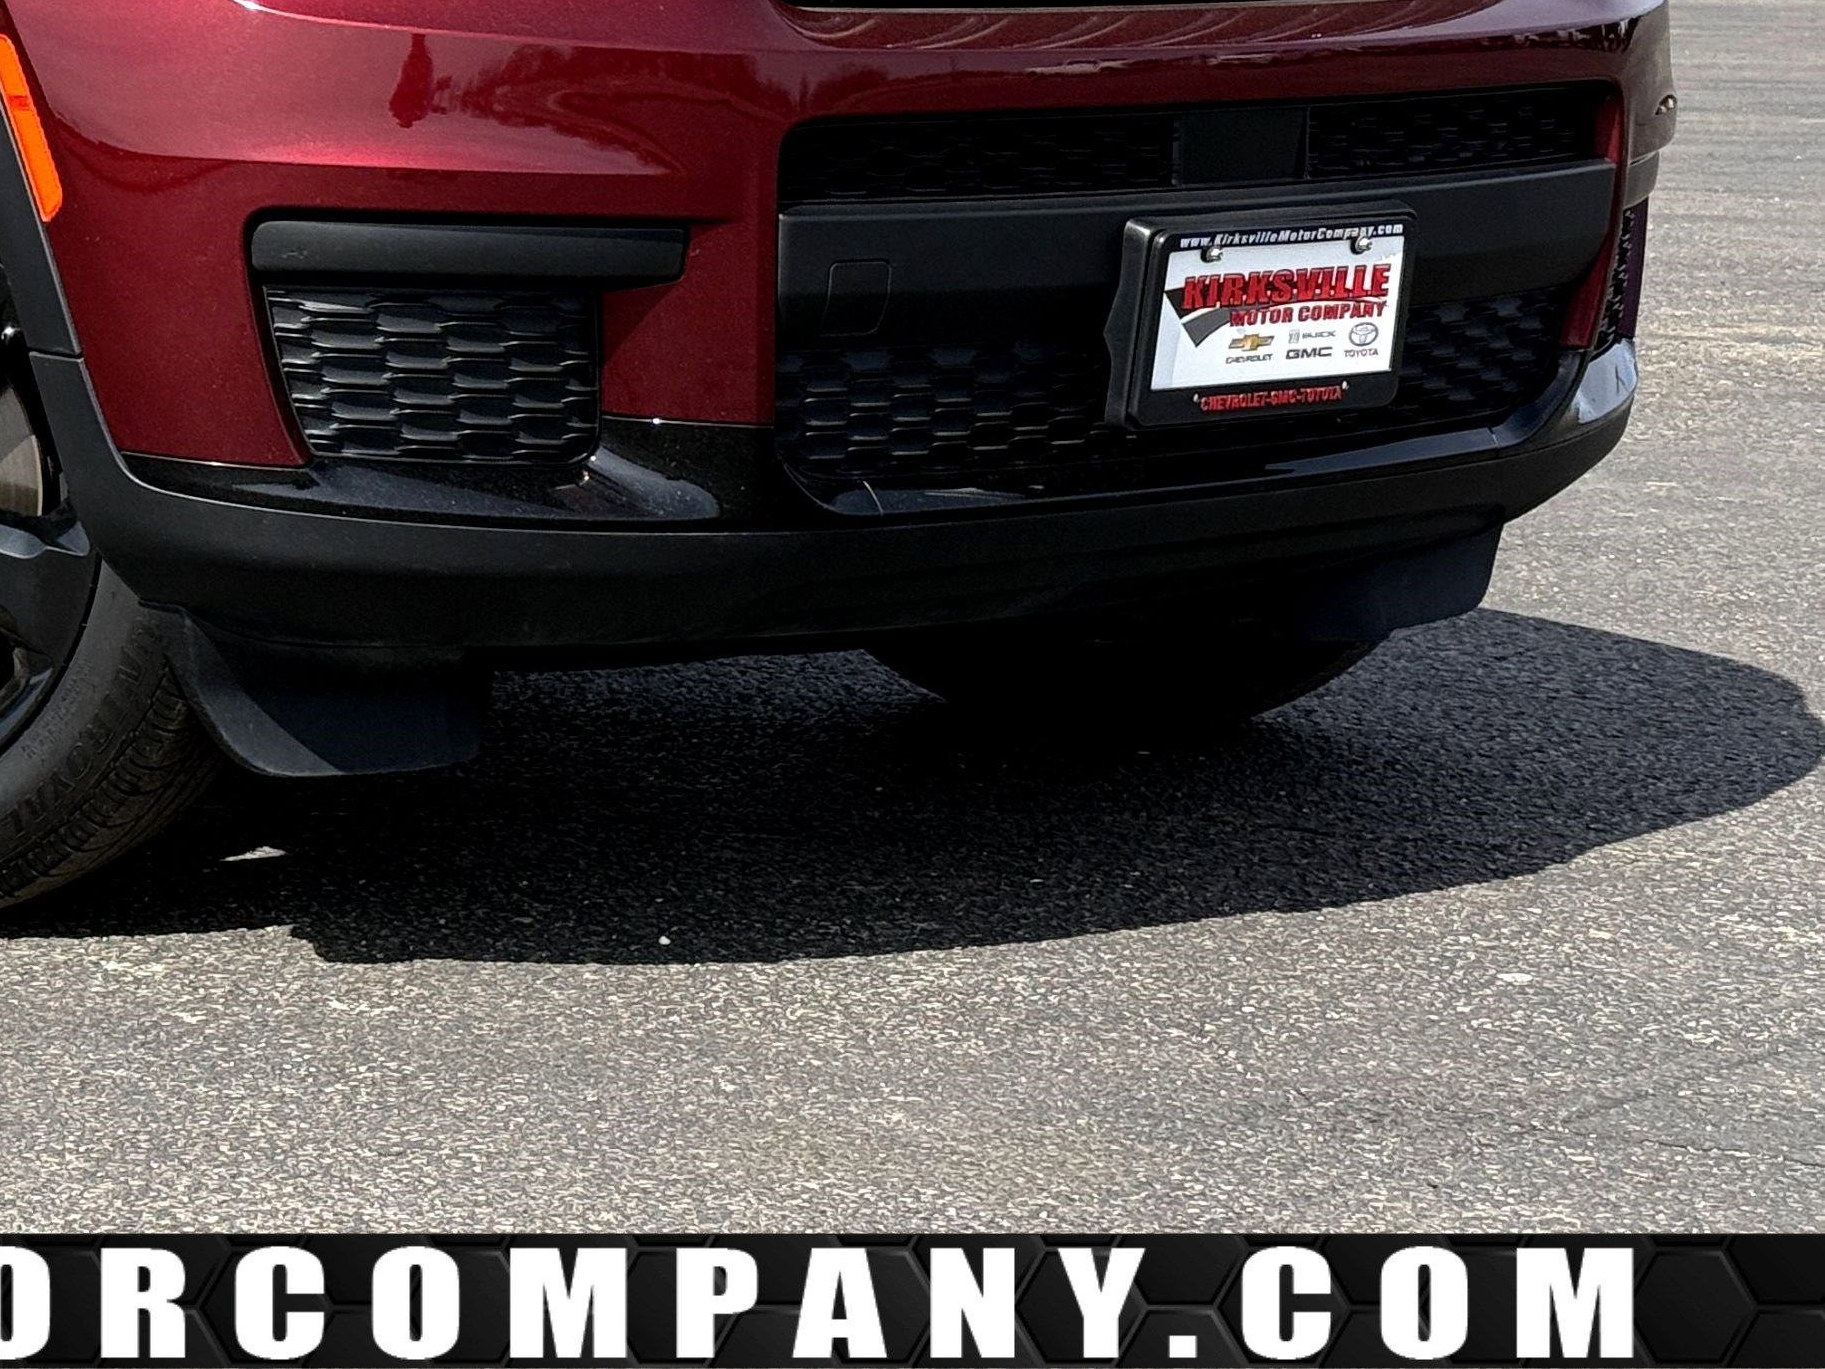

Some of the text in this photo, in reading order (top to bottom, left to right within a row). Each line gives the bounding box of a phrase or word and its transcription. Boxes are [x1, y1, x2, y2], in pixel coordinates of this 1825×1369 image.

[1180, 224, 1404, 249] www.KirksvilleMotorCompany.com
[1181, 263, 1392, 310] KIRKSVILLE
[1229, 298, 1386, 328] MOTOR COMPANY
[1285, 347, 1333, 360] GMC
[1343, 347, 1379, 358] TOYOTA
